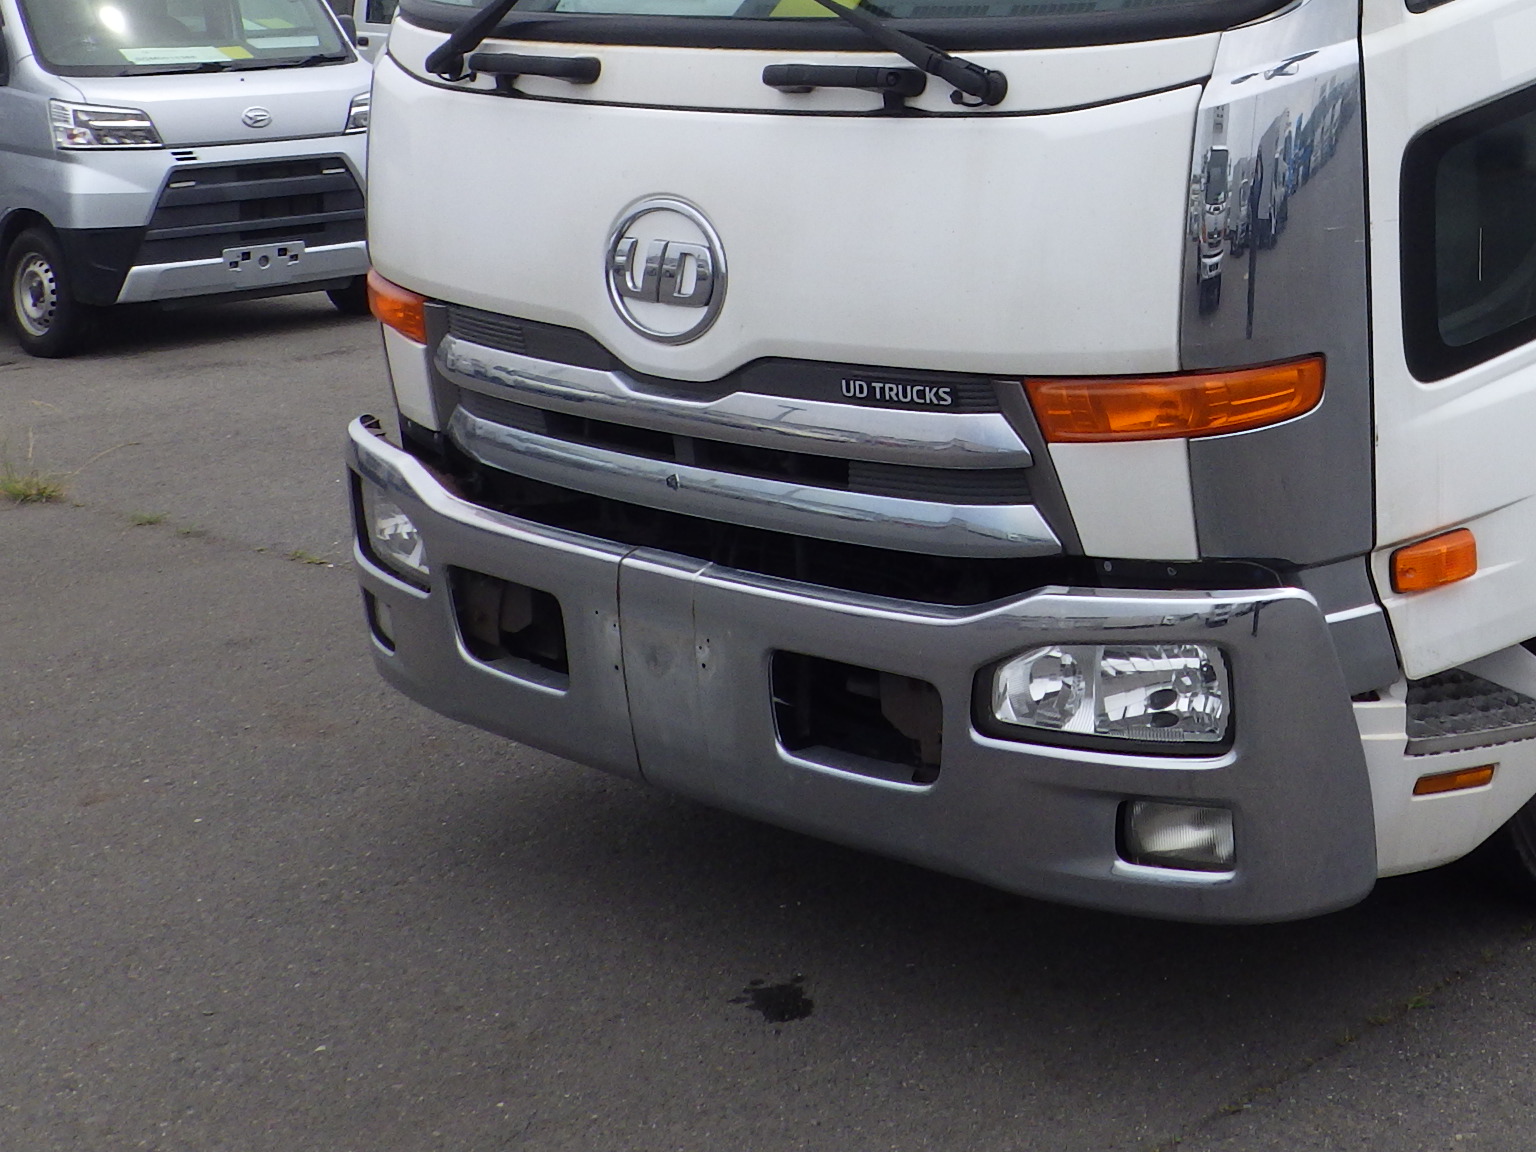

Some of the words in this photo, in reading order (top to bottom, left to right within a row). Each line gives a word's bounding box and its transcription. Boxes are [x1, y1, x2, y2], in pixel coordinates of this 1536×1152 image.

[613, 236, 713, 308] UD
[841, 379, 868, 398] UD
[871, 382, 952, 405] TRUCKS
